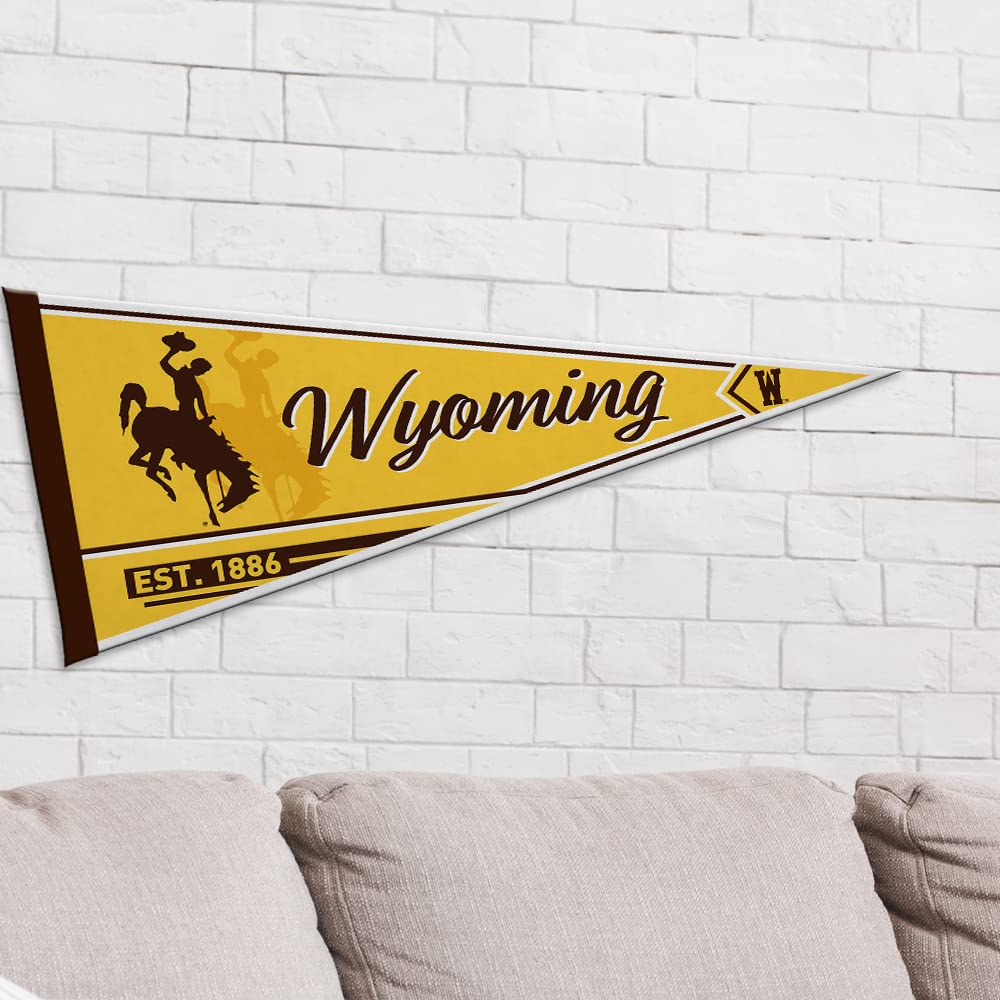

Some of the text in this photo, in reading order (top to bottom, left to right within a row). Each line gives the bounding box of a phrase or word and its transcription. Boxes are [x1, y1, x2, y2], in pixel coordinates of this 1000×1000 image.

[754, 368, 783, 406] W
[282, 368, 671, 471] Wyoming
[133, 551, 282, 595] EST. 1886
